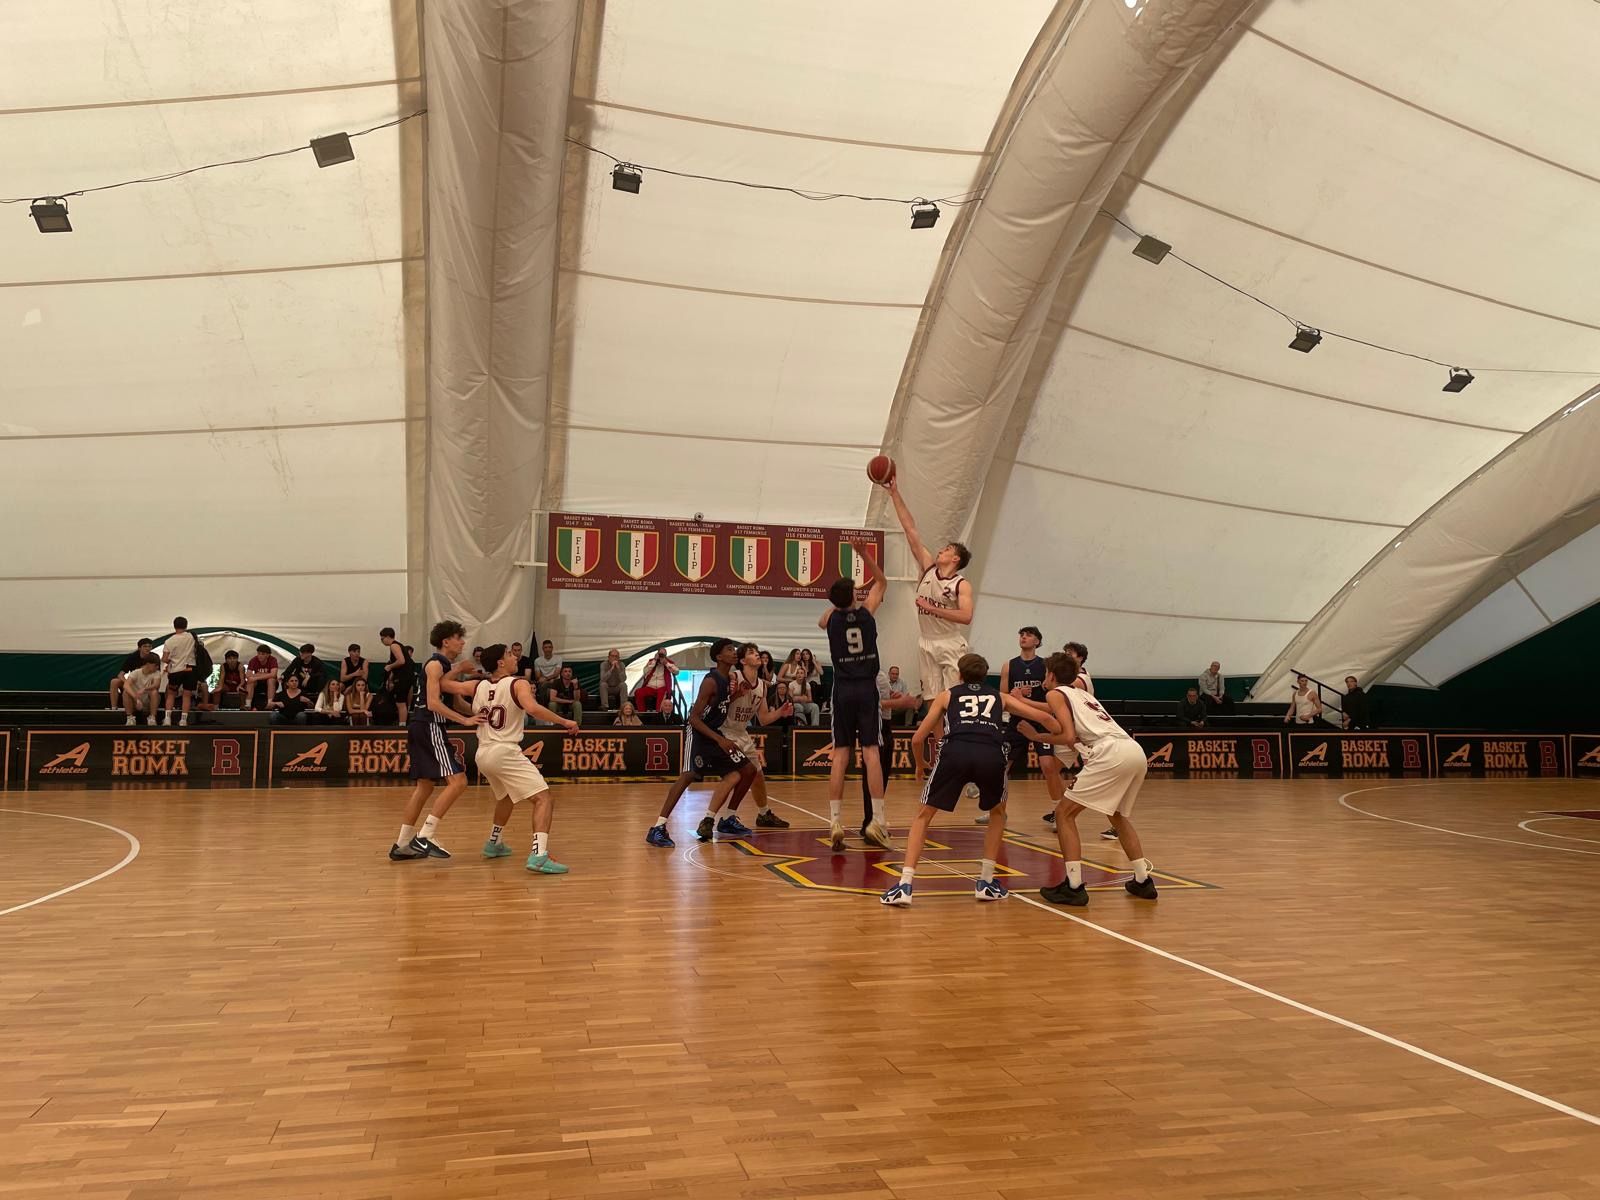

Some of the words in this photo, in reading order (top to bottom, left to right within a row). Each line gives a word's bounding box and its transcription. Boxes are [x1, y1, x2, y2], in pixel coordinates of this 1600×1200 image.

[942, 586, 951, 599] 2
[846, 628, 863, 654] 9
[1014, 680, 1042, 688] COLLEG
[488, 690, 495, 701] B
[958, 694, 996, 718] 37
[113, 739, 190, 755] BASKET
[349, 739, 408, 754] BASKE
[562, 738, 627, 752] BASKET
[1188, 740, 1237, 753] BASKET
[1341, 740, 1388, 752] BASKET
[1483, 742, 1527, 753] BASKET
[211, 738, 241, 776] B
[561, 753, 627, 770] ROMA
[645, 738, 669, 770] B
[1188, 753, 1239, 769] ROMA
[1252, 739, 1272, 769] B
[1342, 752, 1390, 768] ROMA
[1402, 739, 1421, 768] B
[1484, 753, 1528, 768] ROMA
[1539, 741, 1558, 768] B
[111, 755, 189, 776] ROMA
[281, 764, 327, 772] athletes
